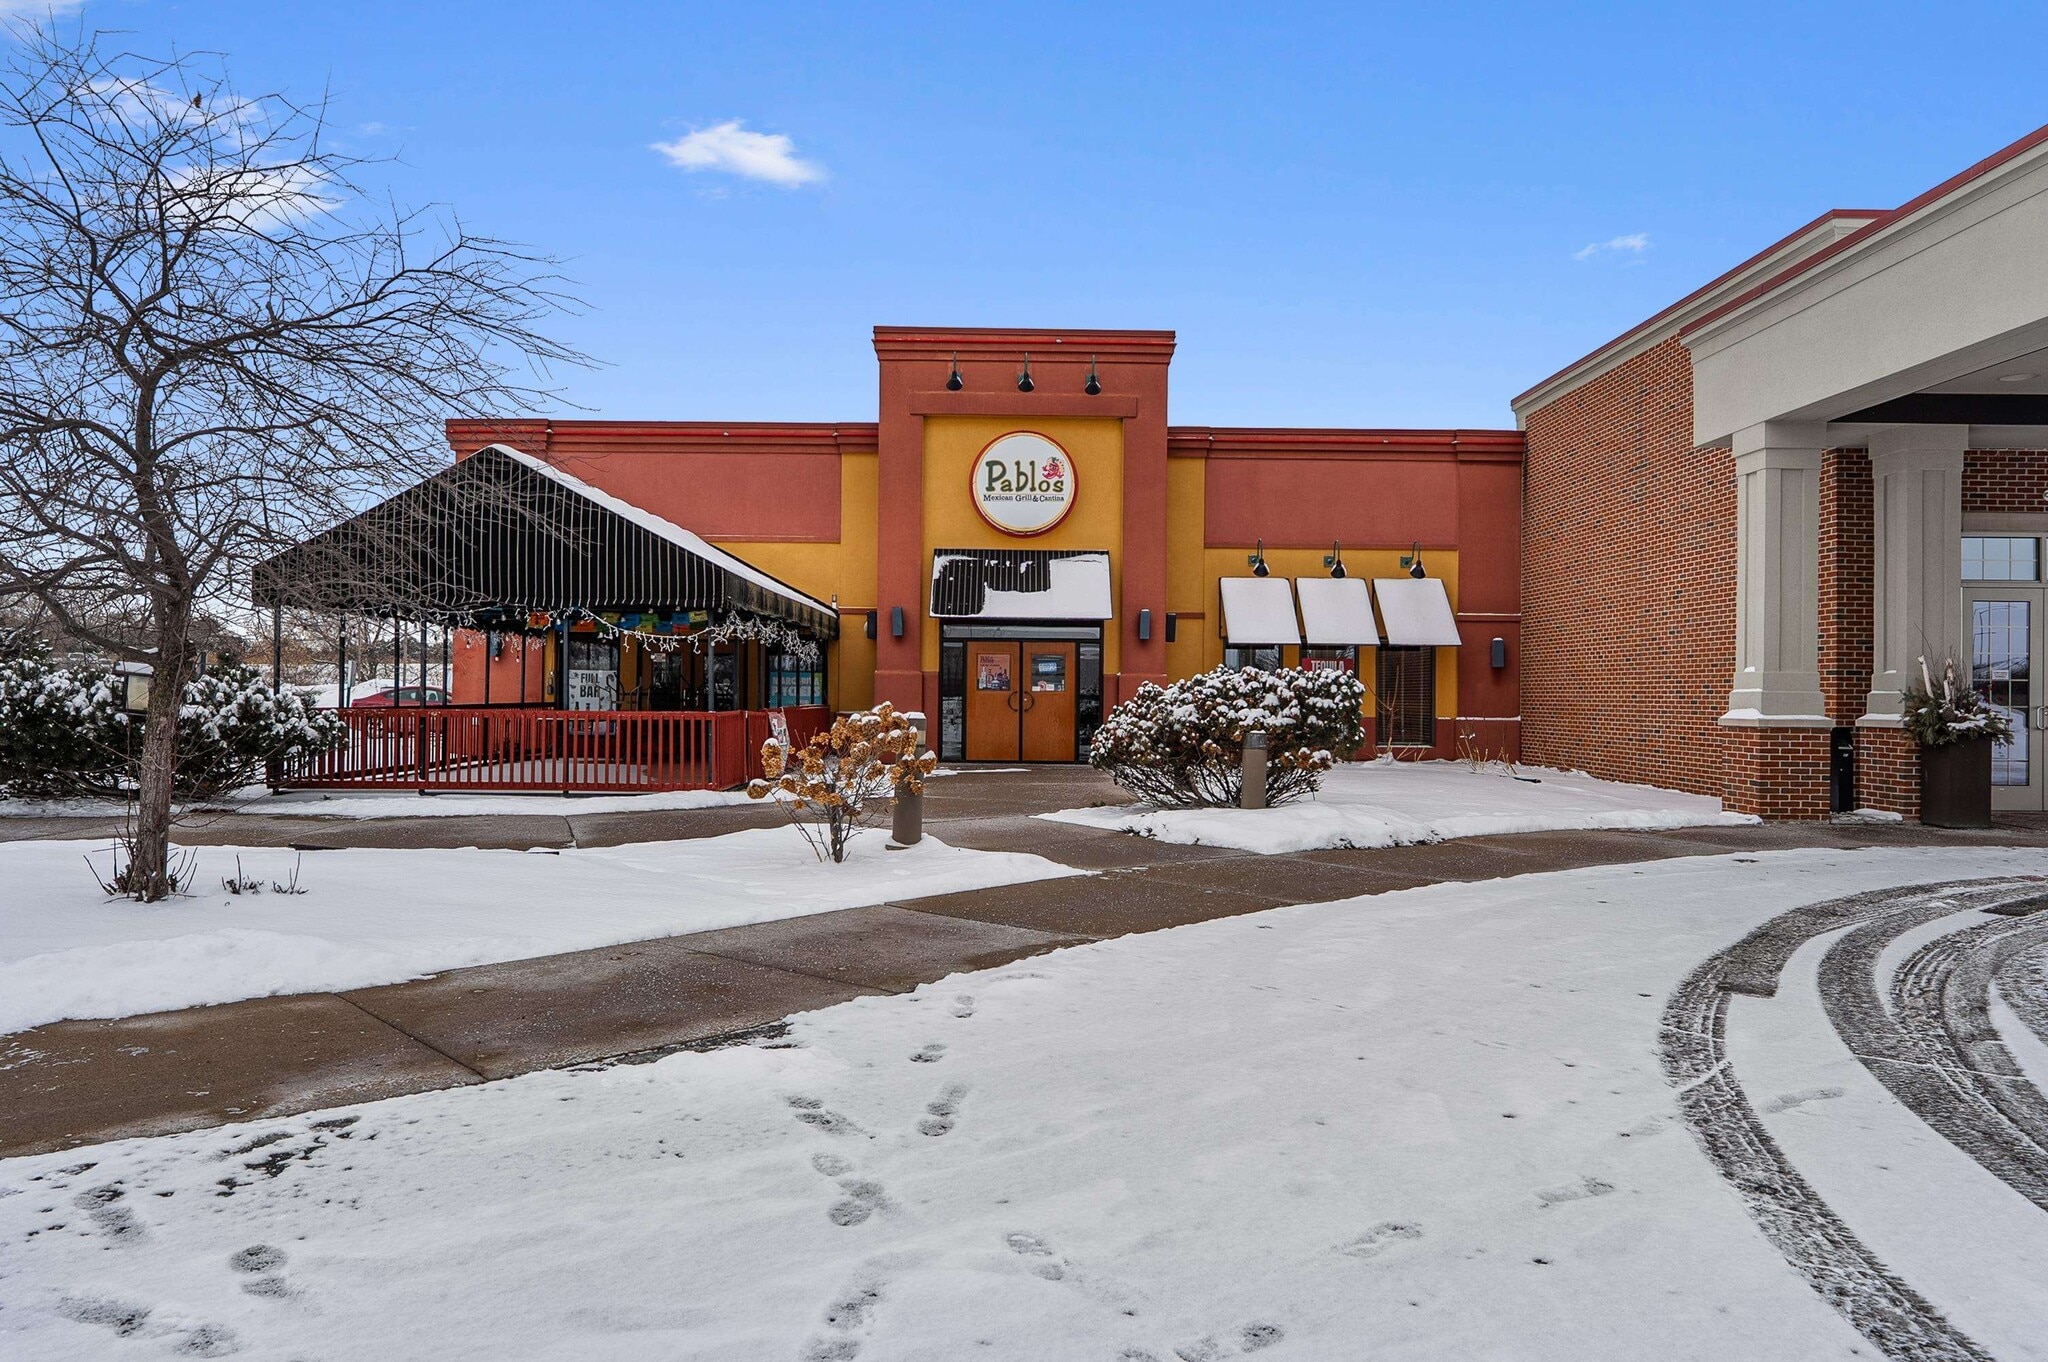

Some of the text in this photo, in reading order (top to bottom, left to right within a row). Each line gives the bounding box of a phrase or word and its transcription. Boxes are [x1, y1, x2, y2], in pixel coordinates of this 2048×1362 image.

[985, 460, 1064, 493] Pablos
[983, 494, 1014, 502] Mexican
[1015, 494, 1032, 502] Grill
[580, 673, 600, 684] FULL
[580, 685, 600, 698] BAR
